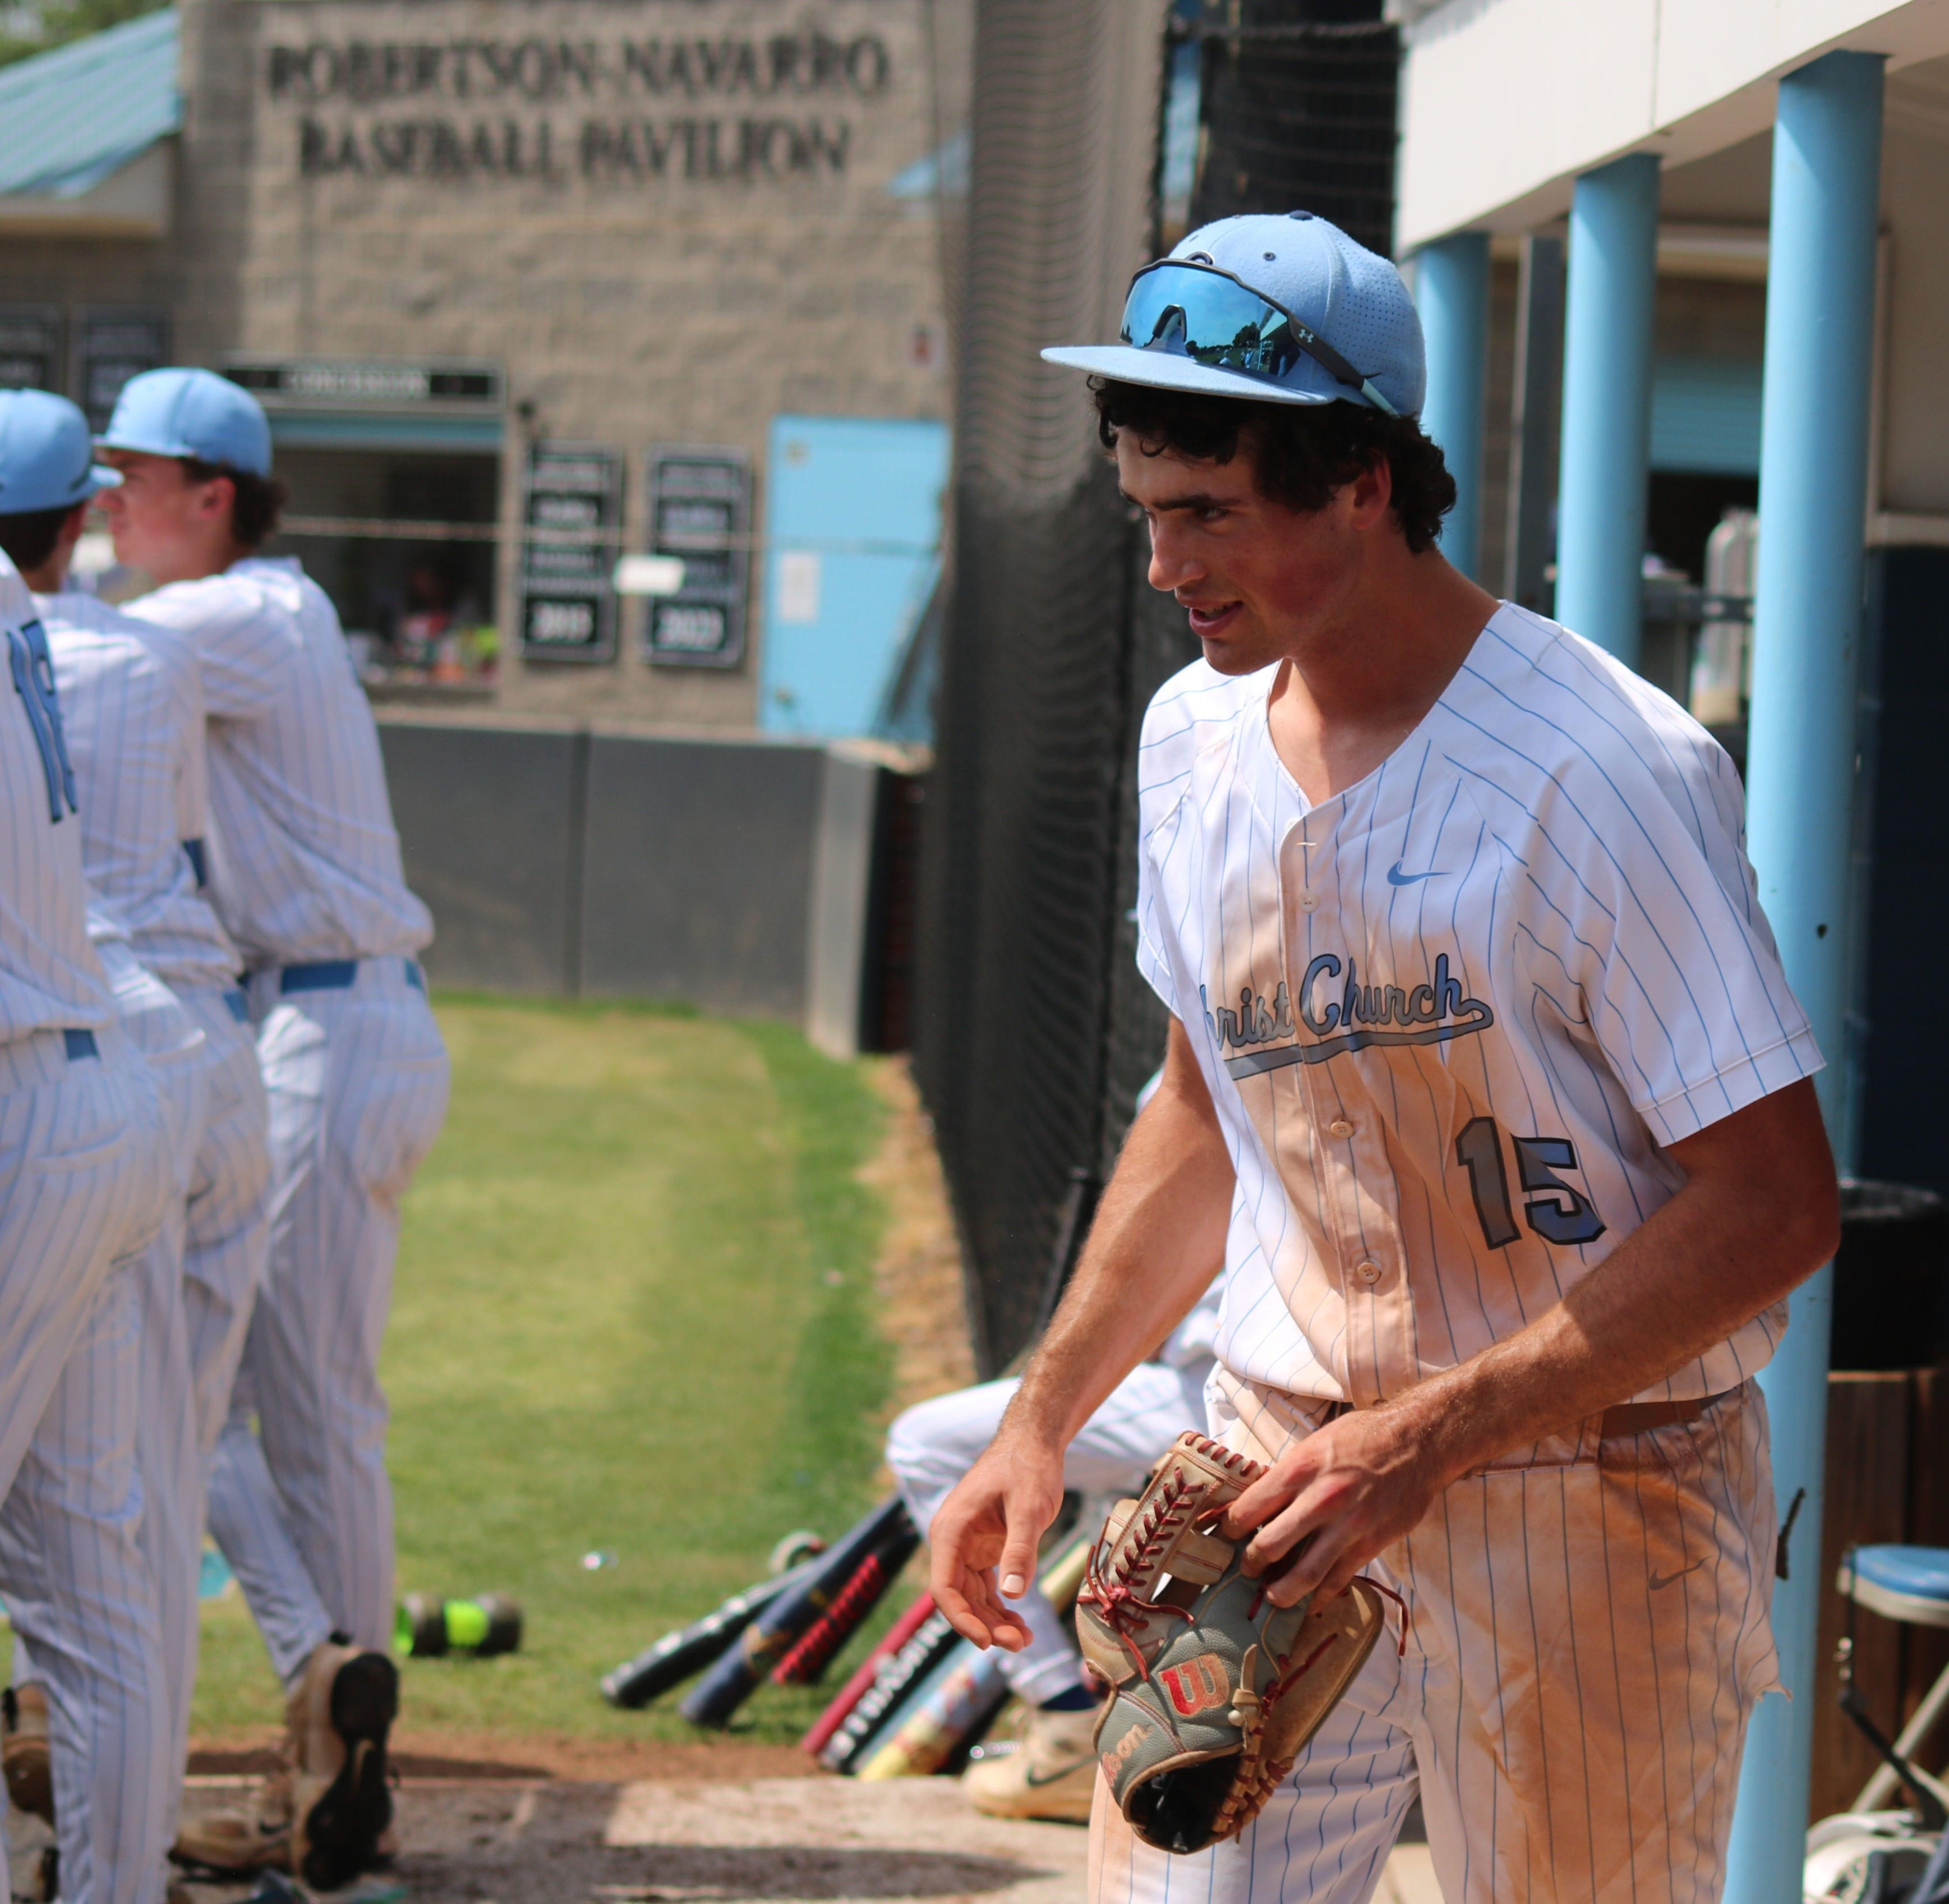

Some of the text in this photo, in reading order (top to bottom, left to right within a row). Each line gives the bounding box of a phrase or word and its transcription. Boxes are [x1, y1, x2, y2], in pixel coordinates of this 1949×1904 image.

[299, 117, 853, 176] BASEBALL PAVILION
[1199, 953, 1494, 1051] hrist Church
[1455, 1116, 1608, 1250] 15
